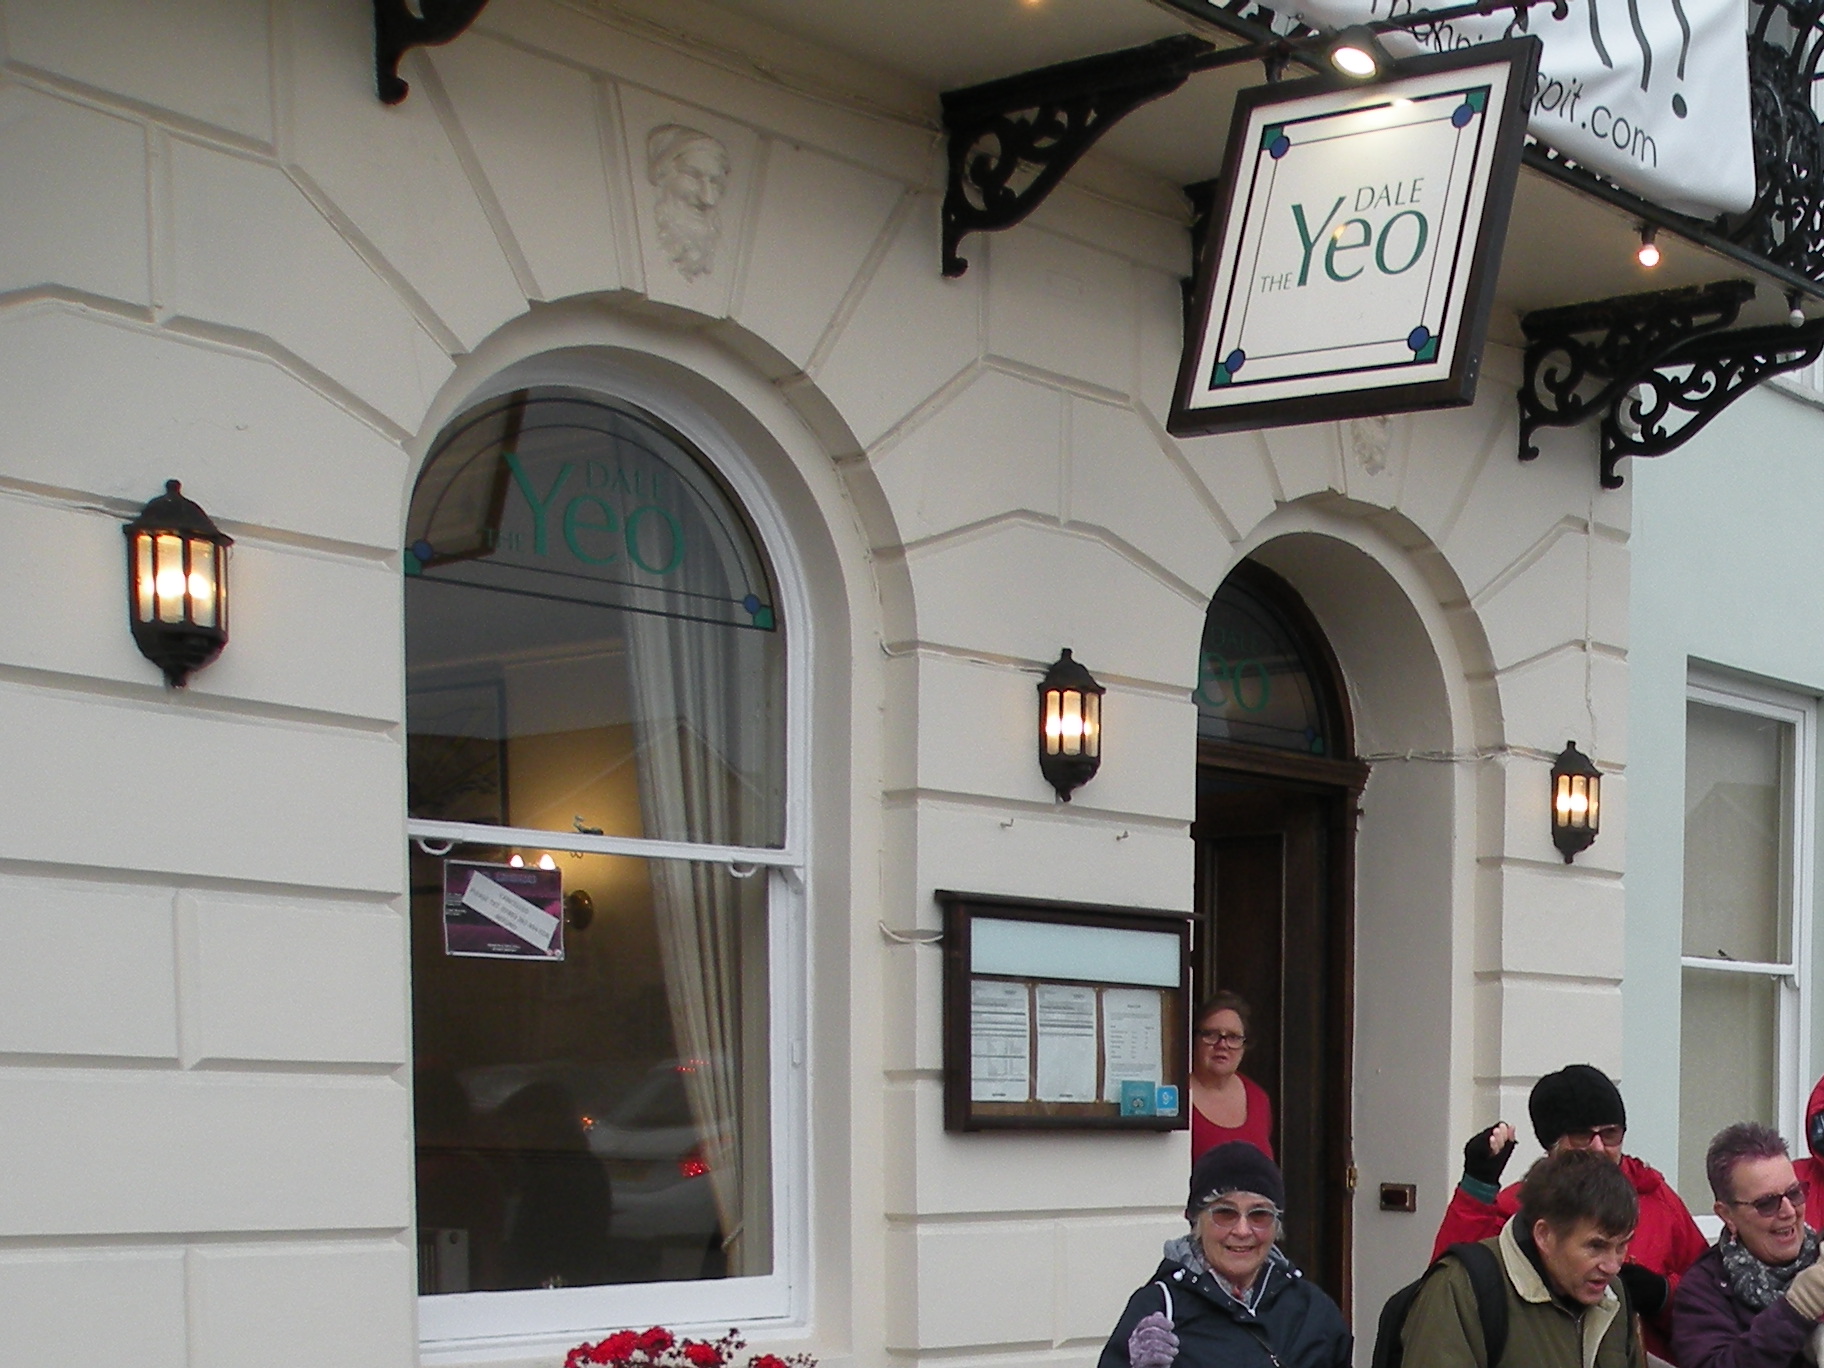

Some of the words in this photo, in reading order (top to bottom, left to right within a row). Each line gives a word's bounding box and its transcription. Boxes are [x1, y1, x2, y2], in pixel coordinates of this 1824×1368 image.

[1352, 177, 1426, 213] DALE
[1260, 271, 1295, 295] THE
[1290, 195, 1430, 288] Yeo
[585, 459, 664, 501] DALE
[501, 451, 686, 576] Yeo
[1198, 651, 1271, 714] eo
